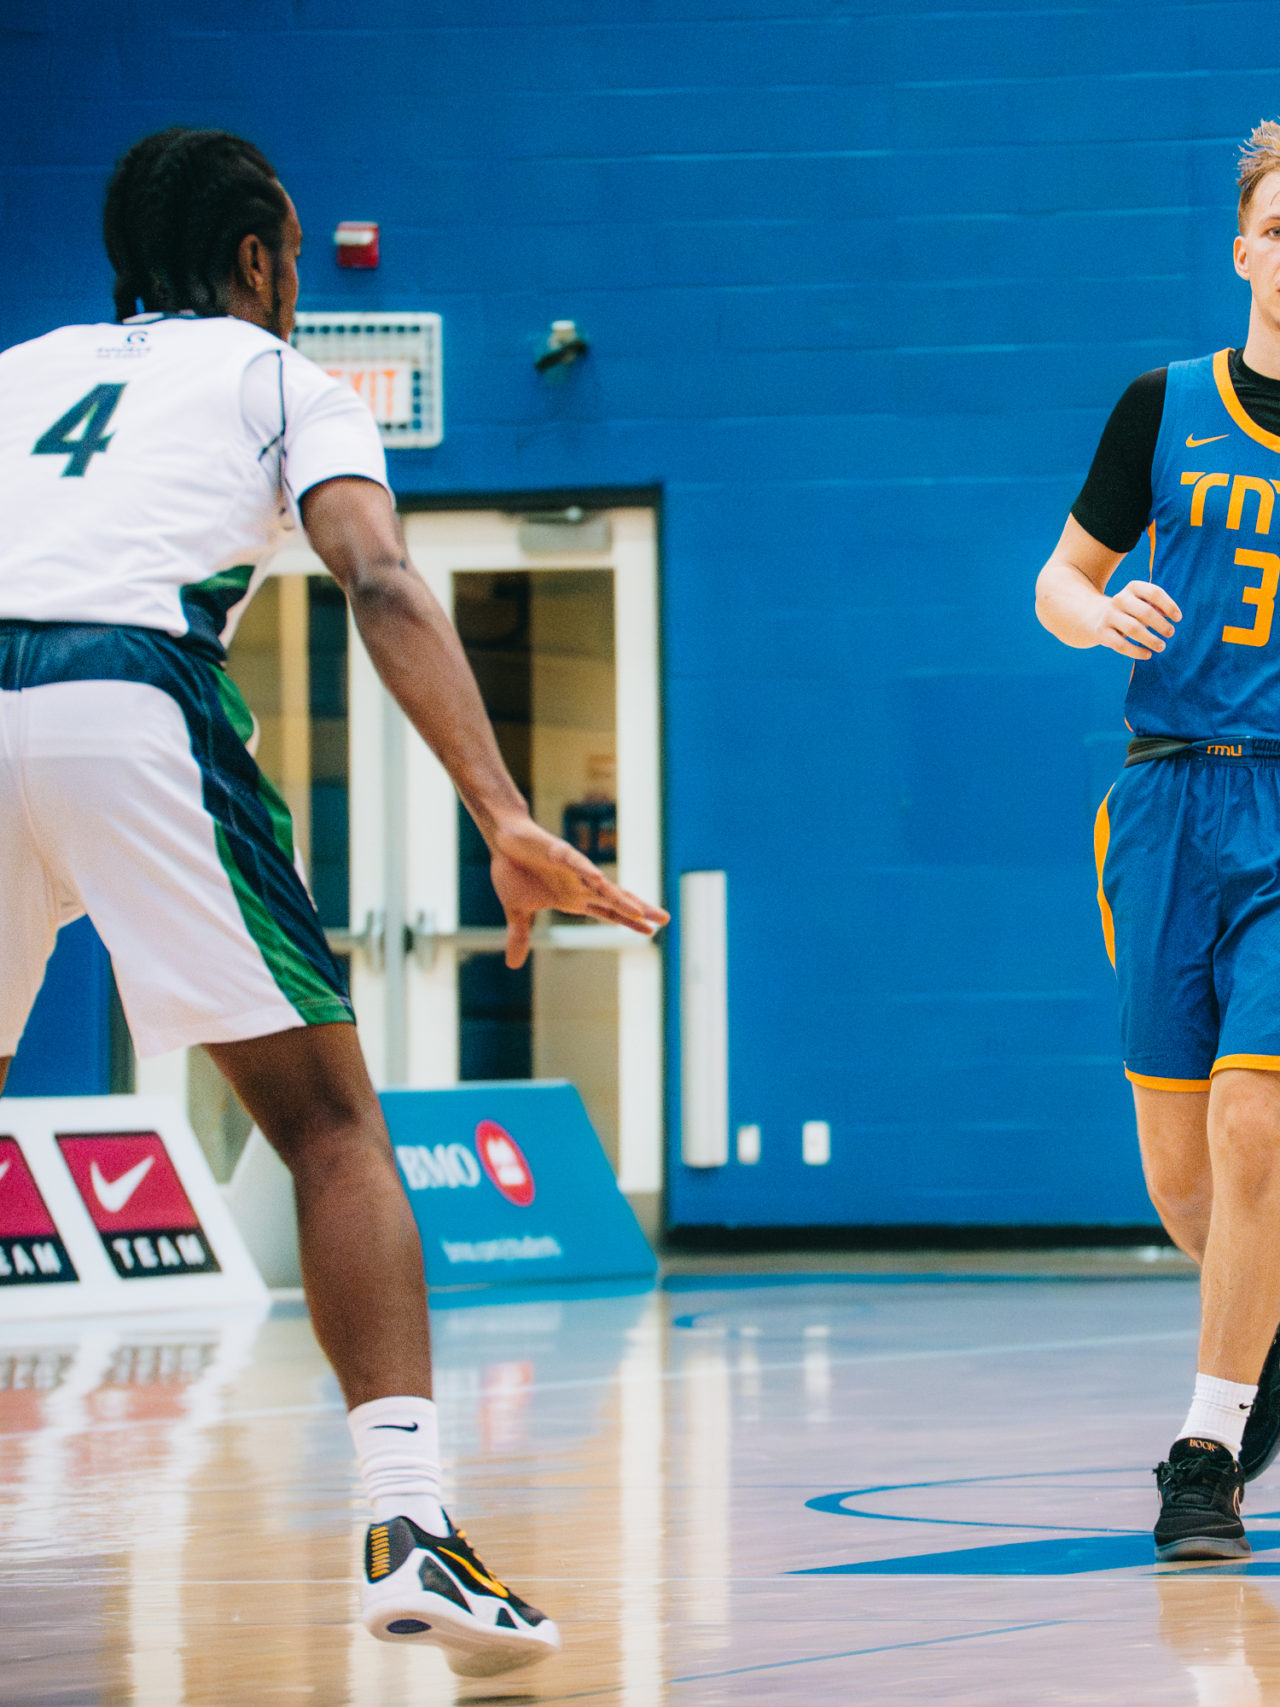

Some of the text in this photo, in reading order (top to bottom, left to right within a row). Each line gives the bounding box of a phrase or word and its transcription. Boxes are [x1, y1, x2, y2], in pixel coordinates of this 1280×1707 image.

[325, 370, 397, 417] XIT
[30, 383, 128, 478] 4
[1222, 548, 1280, 647] 3
[395, 1143, 481, 1190] BMO
[0, 1242, 61, 1277] EAM
[112, 1234, 205, 1270] TEAM
